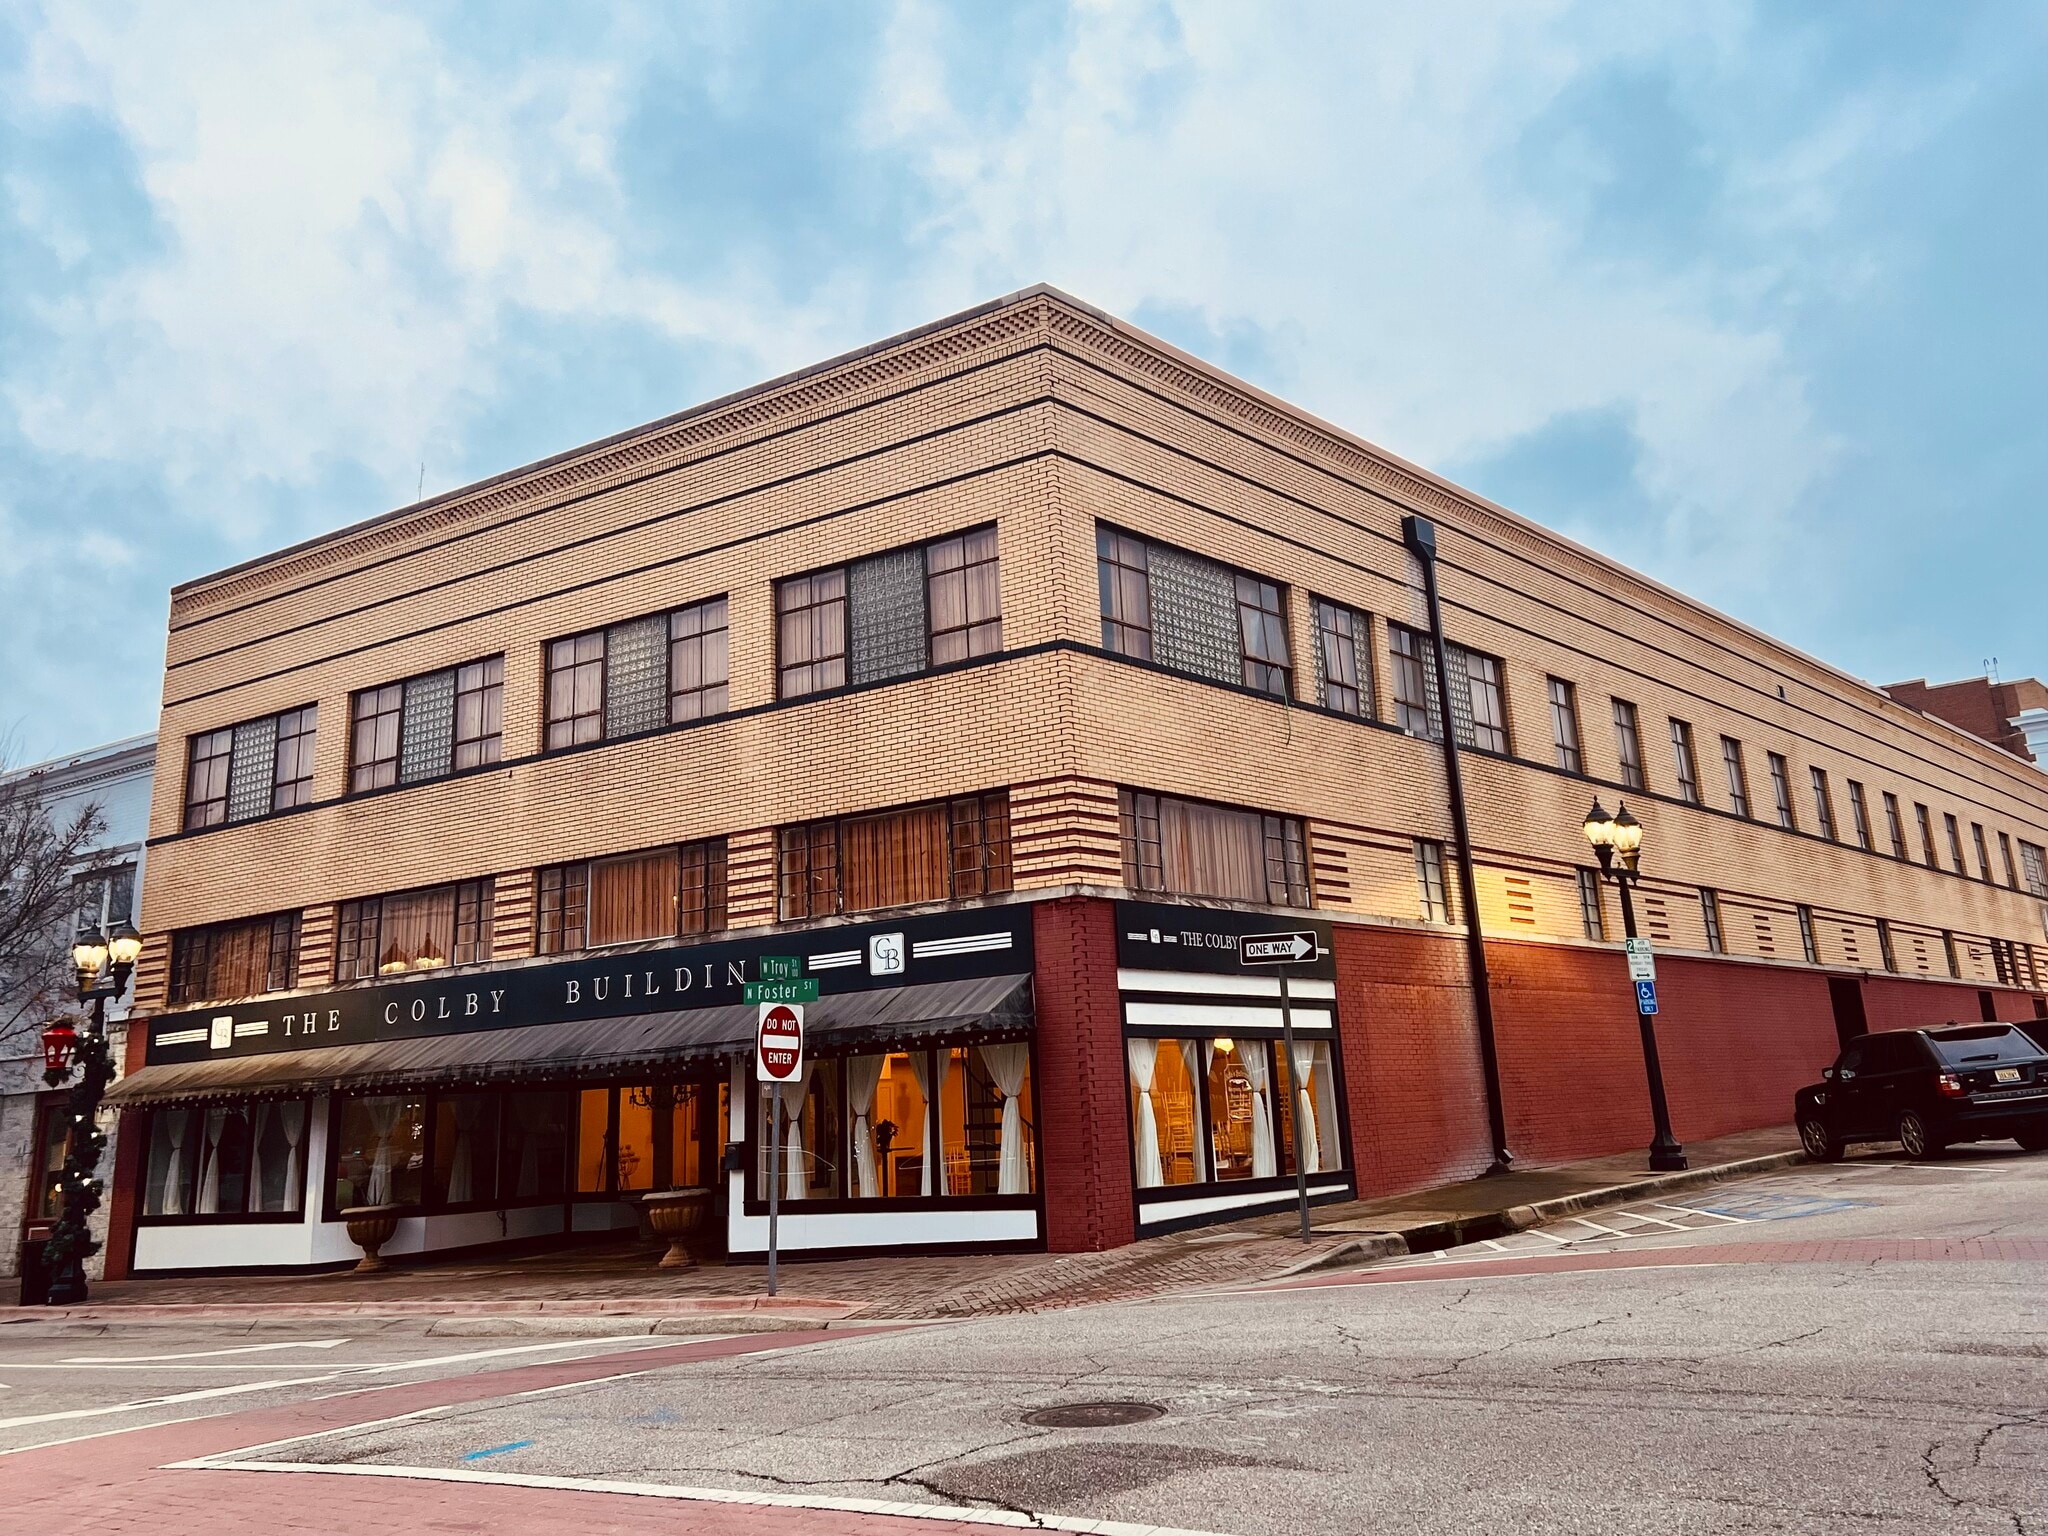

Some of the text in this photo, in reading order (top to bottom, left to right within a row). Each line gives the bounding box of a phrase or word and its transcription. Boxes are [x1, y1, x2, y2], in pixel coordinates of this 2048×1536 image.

[1180, 931, 1238, 950] THE COLBY
[1248, 942, 1293, 955] ONE WAY
[1627, 941, 1633, 952] 2
[771, 960, 789, 979] Troy
[791, 959, 798, 967] St
[747, 981, 812, 1000] N Foster St
[283, 960, 747, 1038] THE COLBY BUILDIN
[766, 1018, 796, 1031] DO NOT
[768, 1052, 793, 1065] ENTER
